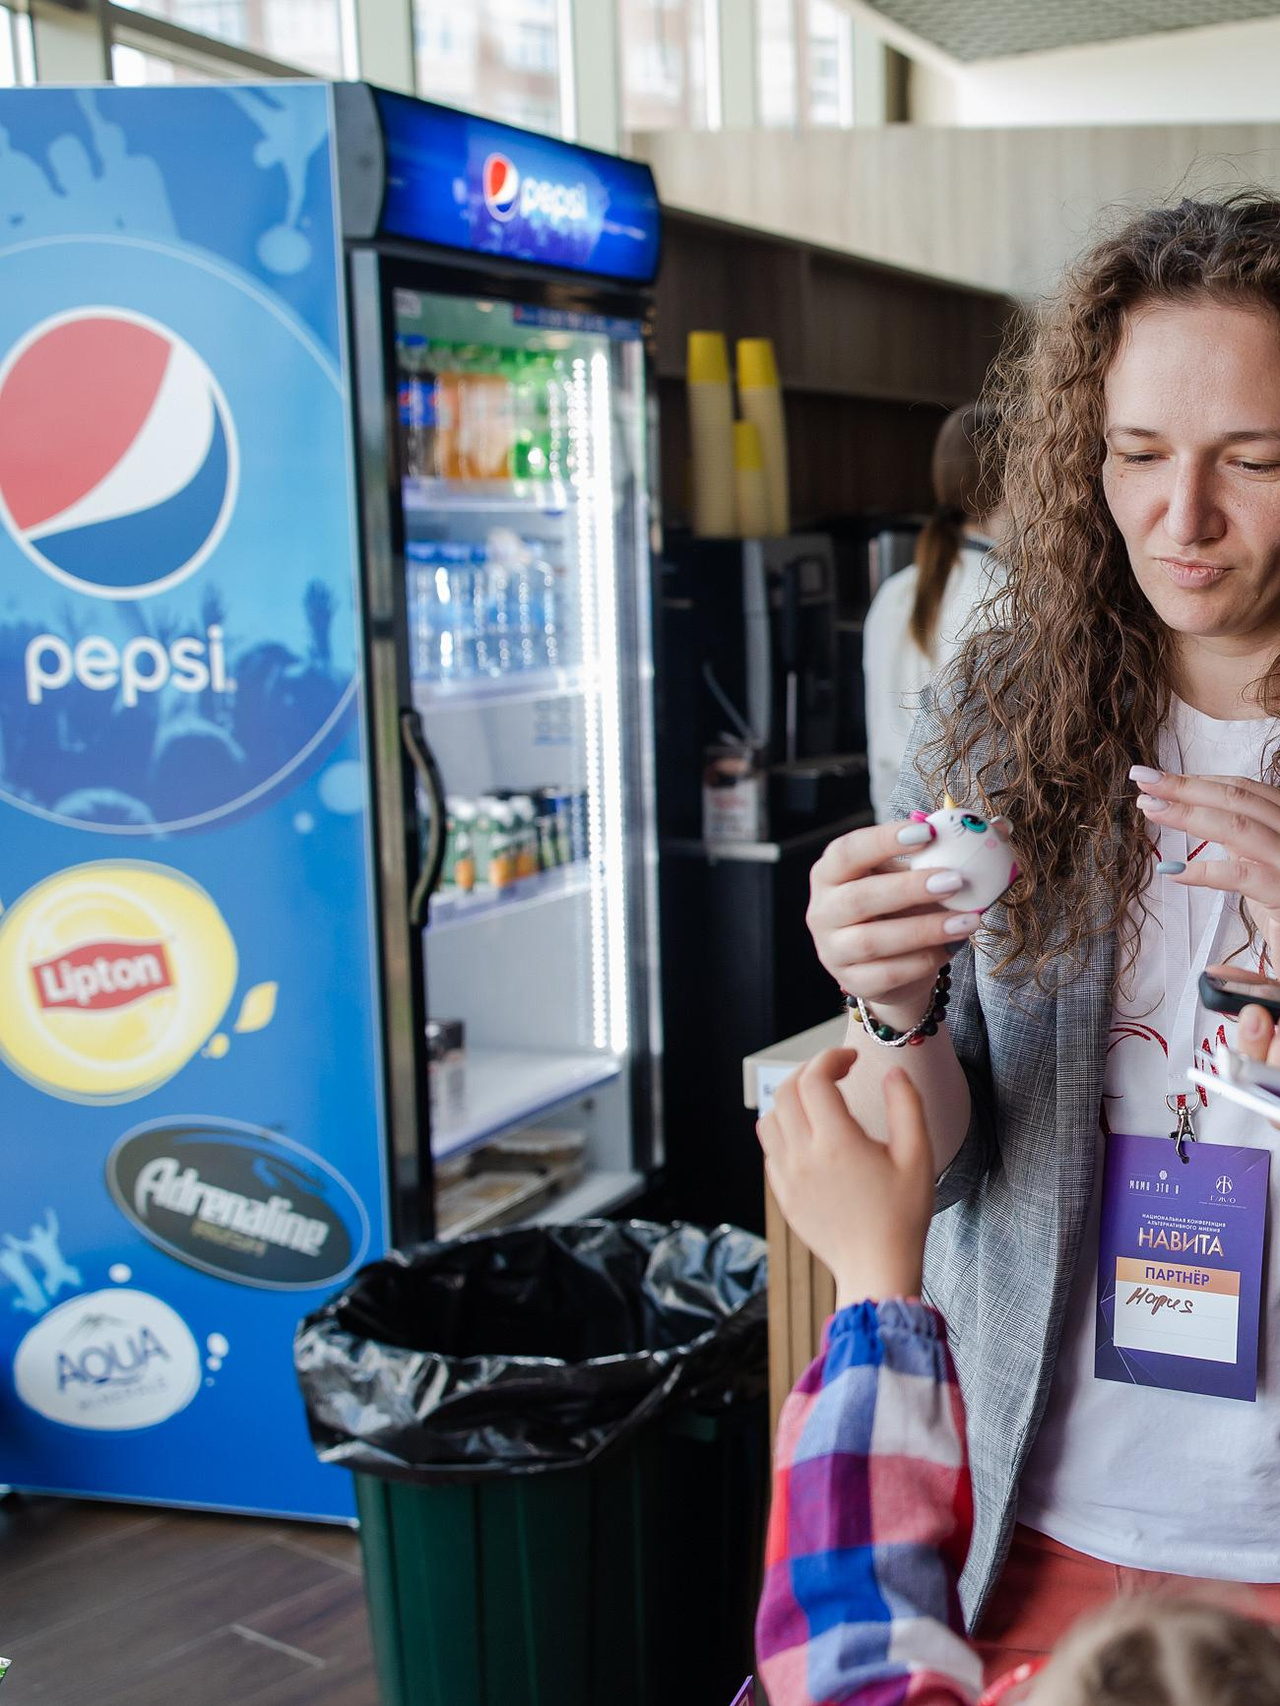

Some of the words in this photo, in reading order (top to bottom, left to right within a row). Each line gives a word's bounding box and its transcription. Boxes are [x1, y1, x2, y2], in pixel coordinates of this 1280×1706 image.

[24, 624, 226, 708] pepsi
[41, 953, 164, 1006] Lipton
[134, 1156, 330, 1258] Adrenaline
[1142, 1214, 1186, 1223] НАЦИОНАЛЬНАЯ
[1187, 1218, 1226, 1228] КОНФЕРЕНЦИЯ
[1147, 1221, 1197, 1230] АЛЬТЕРНАТИВНОГО
[1198, 1226, 1221, 1234] МНЕНИЯ
[1139, 1227, 1224, 1257] НАВИТА
[1145, 1266, 1210, 1286] ПАРТНЁР
[56, 1325, 171, 1393] AQUA
